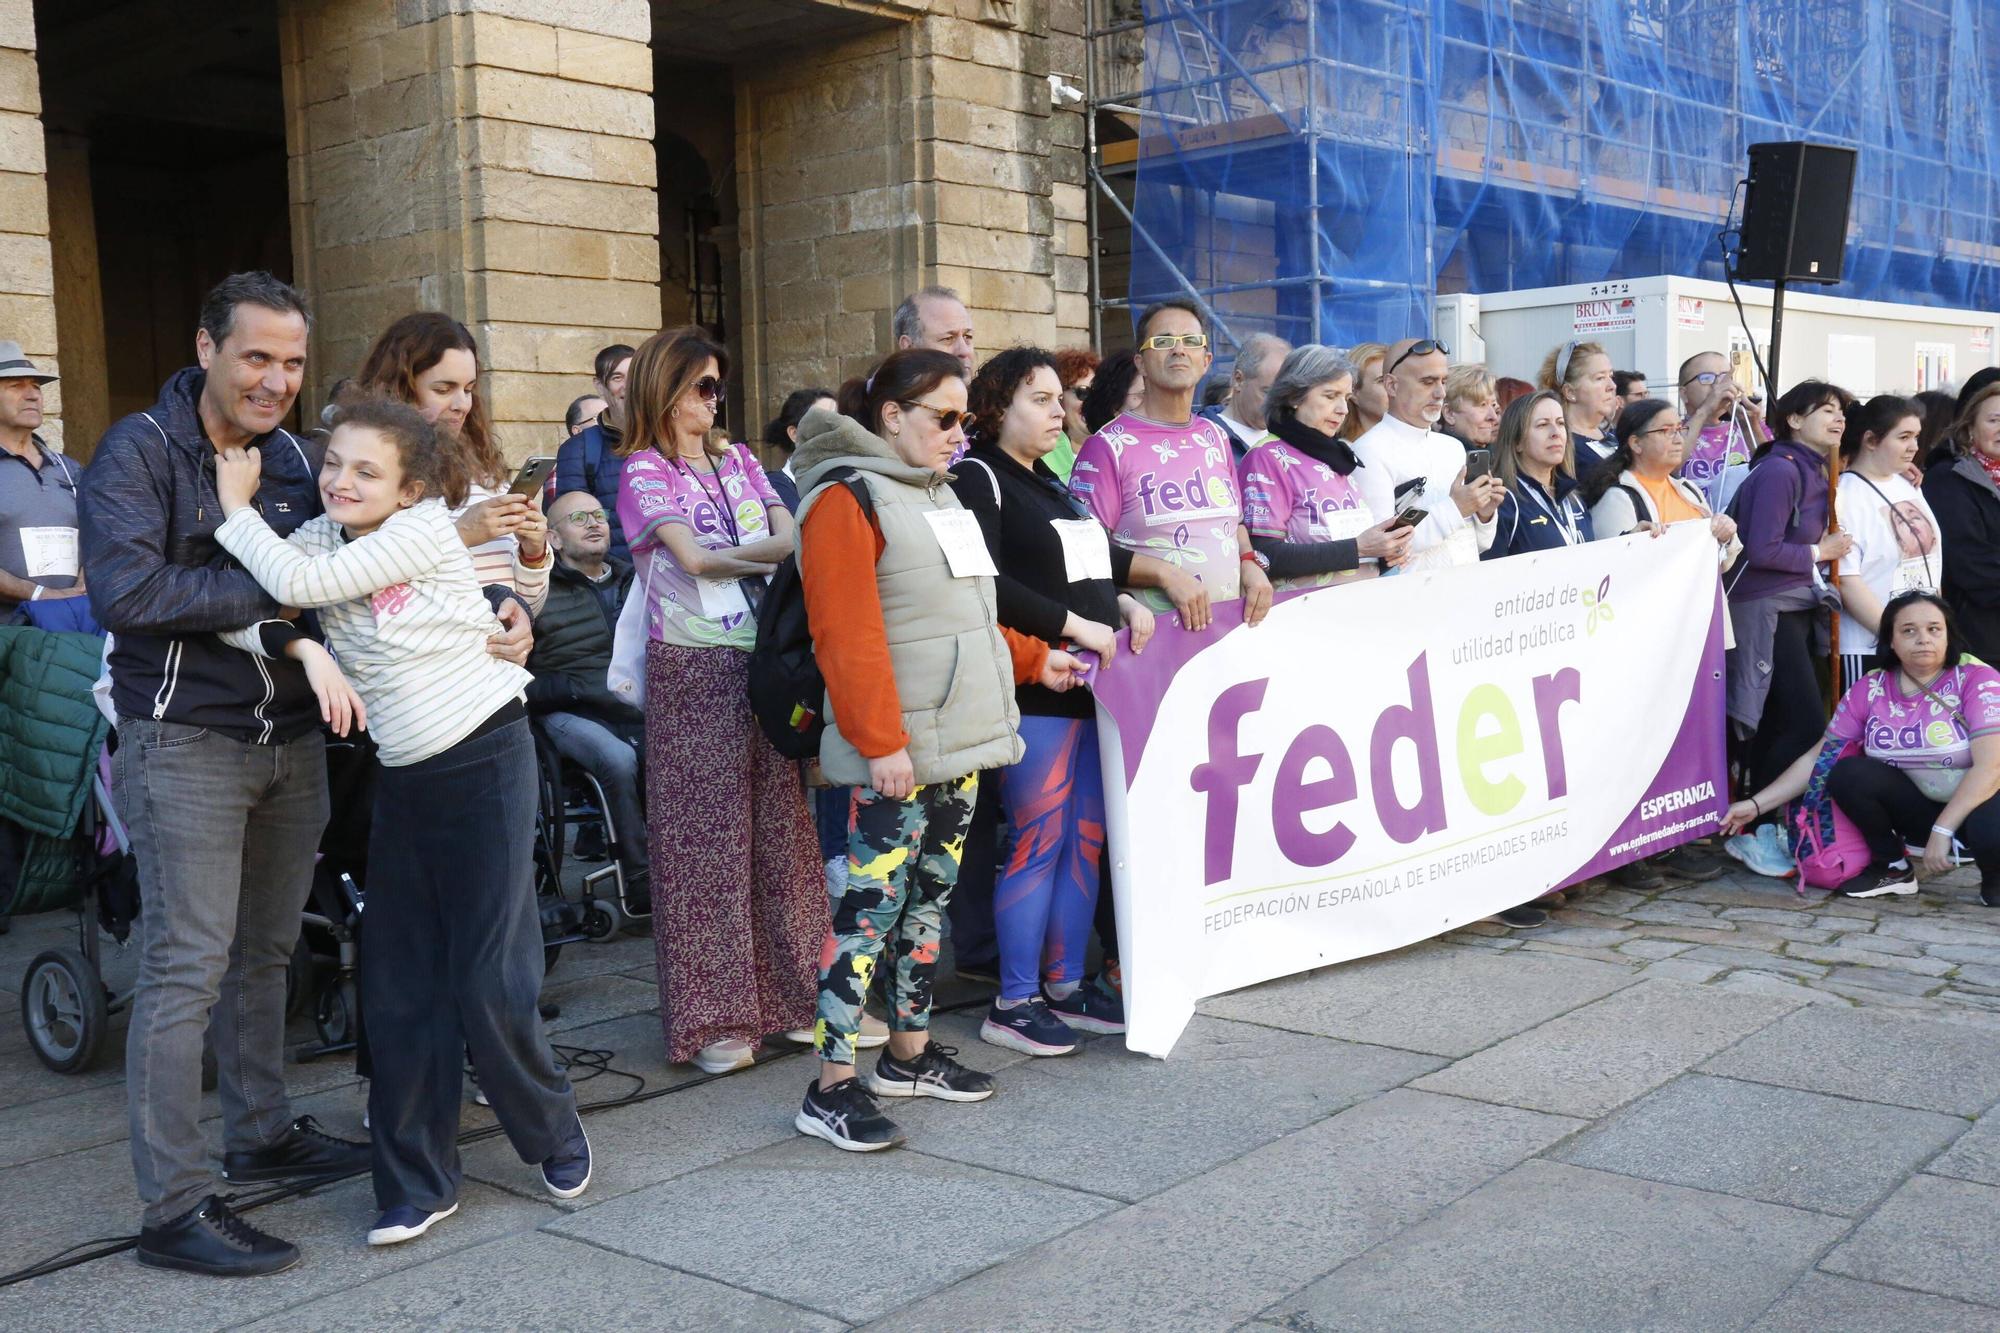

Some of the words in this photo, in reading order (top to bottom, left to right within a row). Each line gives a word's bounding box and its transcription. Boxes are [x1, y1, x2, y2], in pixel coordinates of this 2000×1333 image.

[1576, 300, 1612, 319] BRUN
[1494, 584, 1556, 618] entidad
[1559, 583, 1578, 606] de
[1452, 630, 1514, 665] utilidad
[1519, 620, 1576, 656] pública
[1190, 650, 1580, 886] feder
[1641, 780, 1716, 821] ESPERANZA
[1204, 892, 1310, 934] FEDERACIÓN
[1317, 874, 1401, 909] ESPAÑOLA
[1406, 867, 1424, 889] DE
[1429, 834, 1527, 881] ENFERMEDADES
[1531, 821, 1568, 848] RARAS
